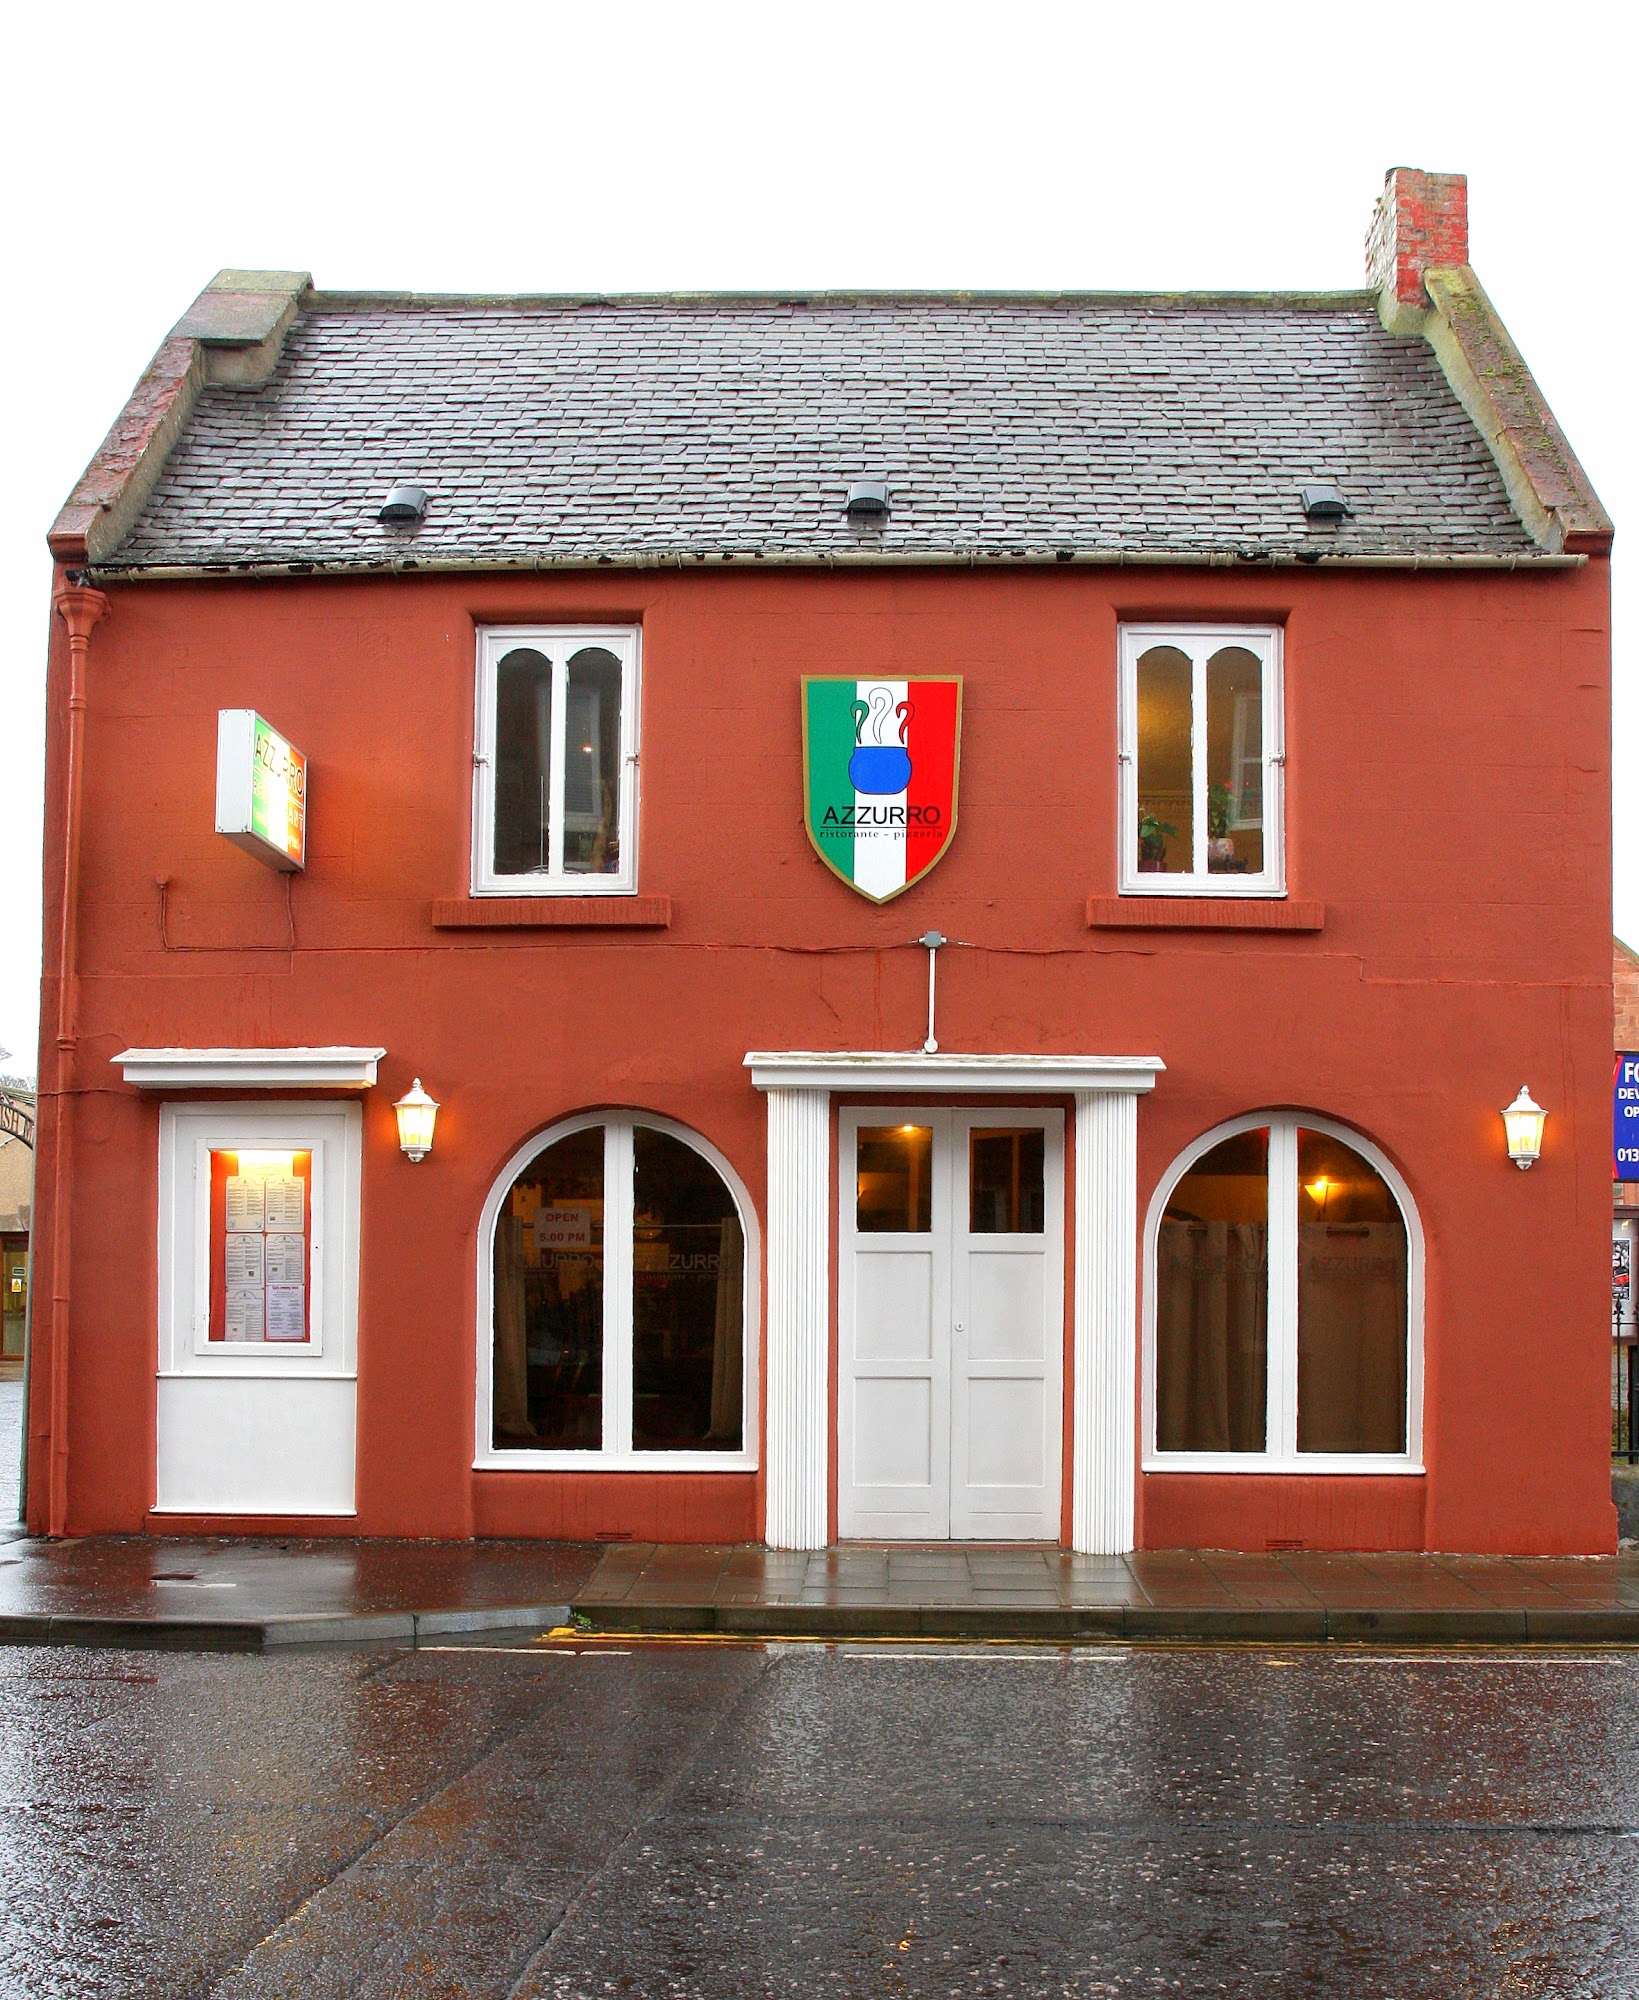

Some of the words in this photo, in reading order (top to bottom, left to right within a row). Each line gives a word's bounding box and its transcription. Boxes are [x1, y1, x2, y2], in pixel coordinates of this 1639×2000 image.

[823, 806, 941, 824] AZZURRO
[820, 830, 879, 838] ristorante
[894, 829, 943, 840] pizzeria
[1617, 1148, 1639, 1162] 013
[546, 1213, 579, 1222] OPEN
[540, 1232, 564, 1242] 5.00
[567, 1232, 585, 1242] PM
